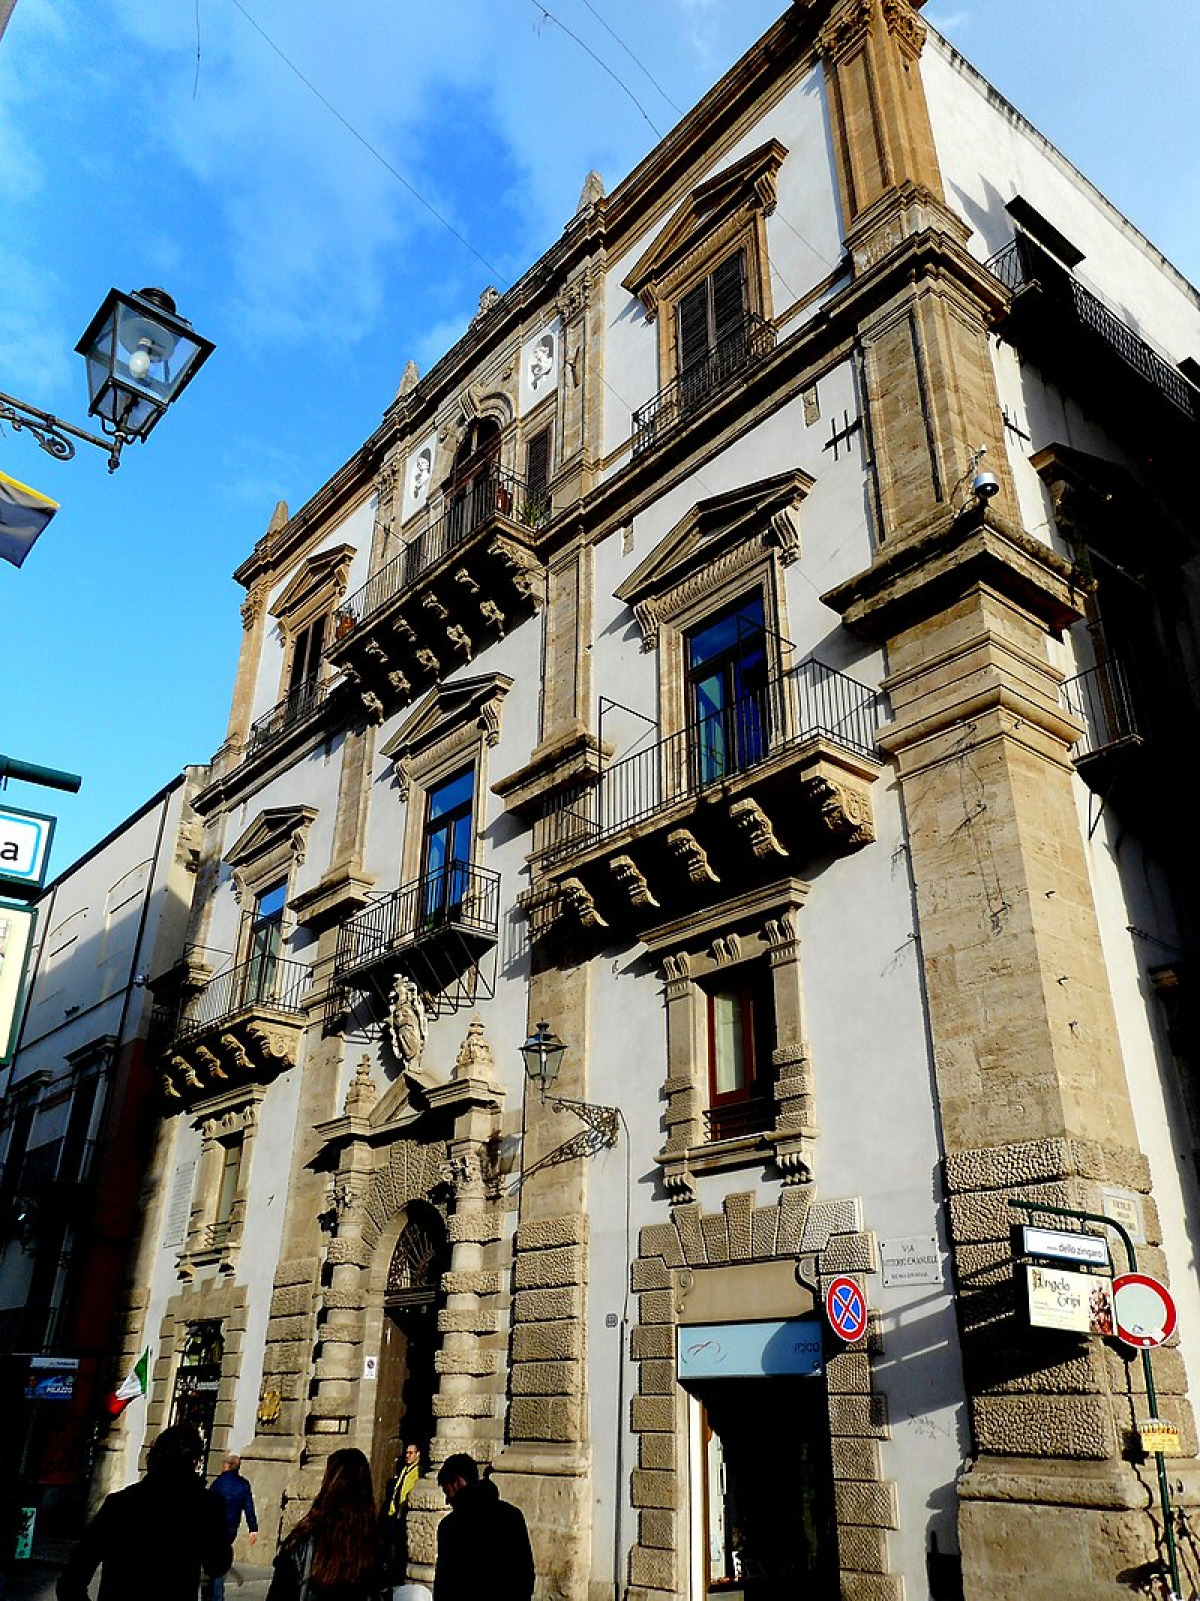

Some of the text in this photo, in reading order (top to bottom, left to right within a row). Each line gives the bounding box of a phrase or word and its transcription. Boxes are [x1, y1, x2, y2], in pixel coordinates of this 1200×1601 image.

[901, 1244, 915, 1253] VIA
[1058, 1243, 1076, 1254] dello
[1076, 1246, 1103, 1259] zingaro
